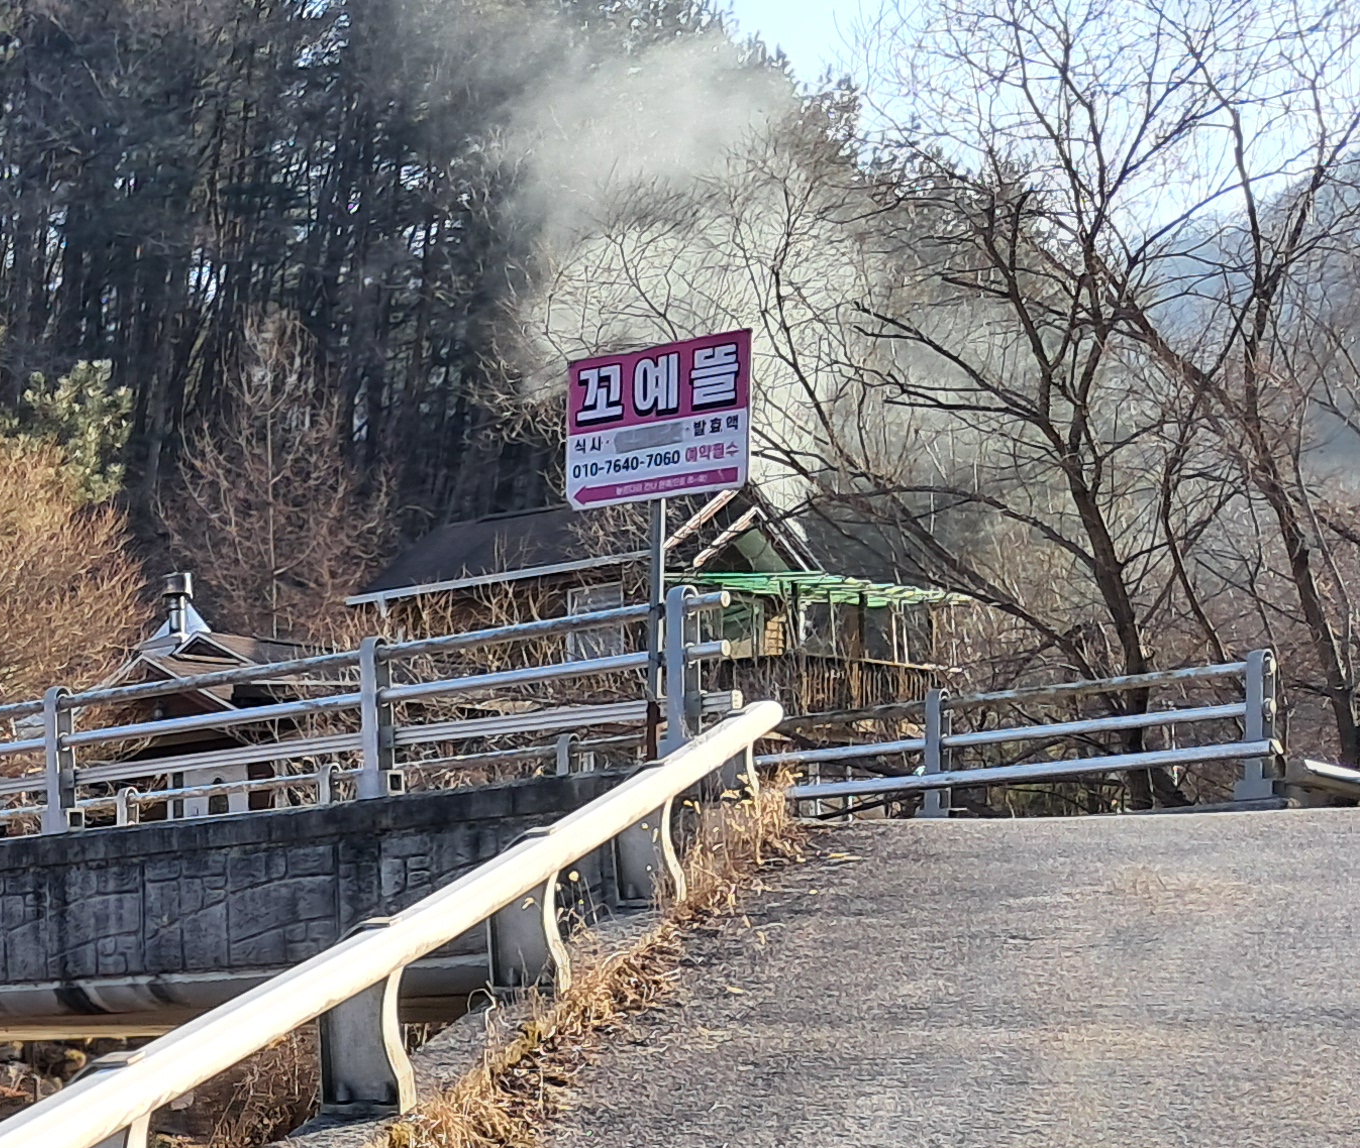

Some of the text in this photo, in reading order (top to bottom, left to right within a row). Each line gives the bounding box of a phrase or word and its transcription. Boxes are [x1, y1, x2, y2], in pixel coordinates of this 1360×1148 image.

[576, 342, 740, 426] 꼬예뜰
[573, 441, 740, 479] 010-7640-7060 예약필수
